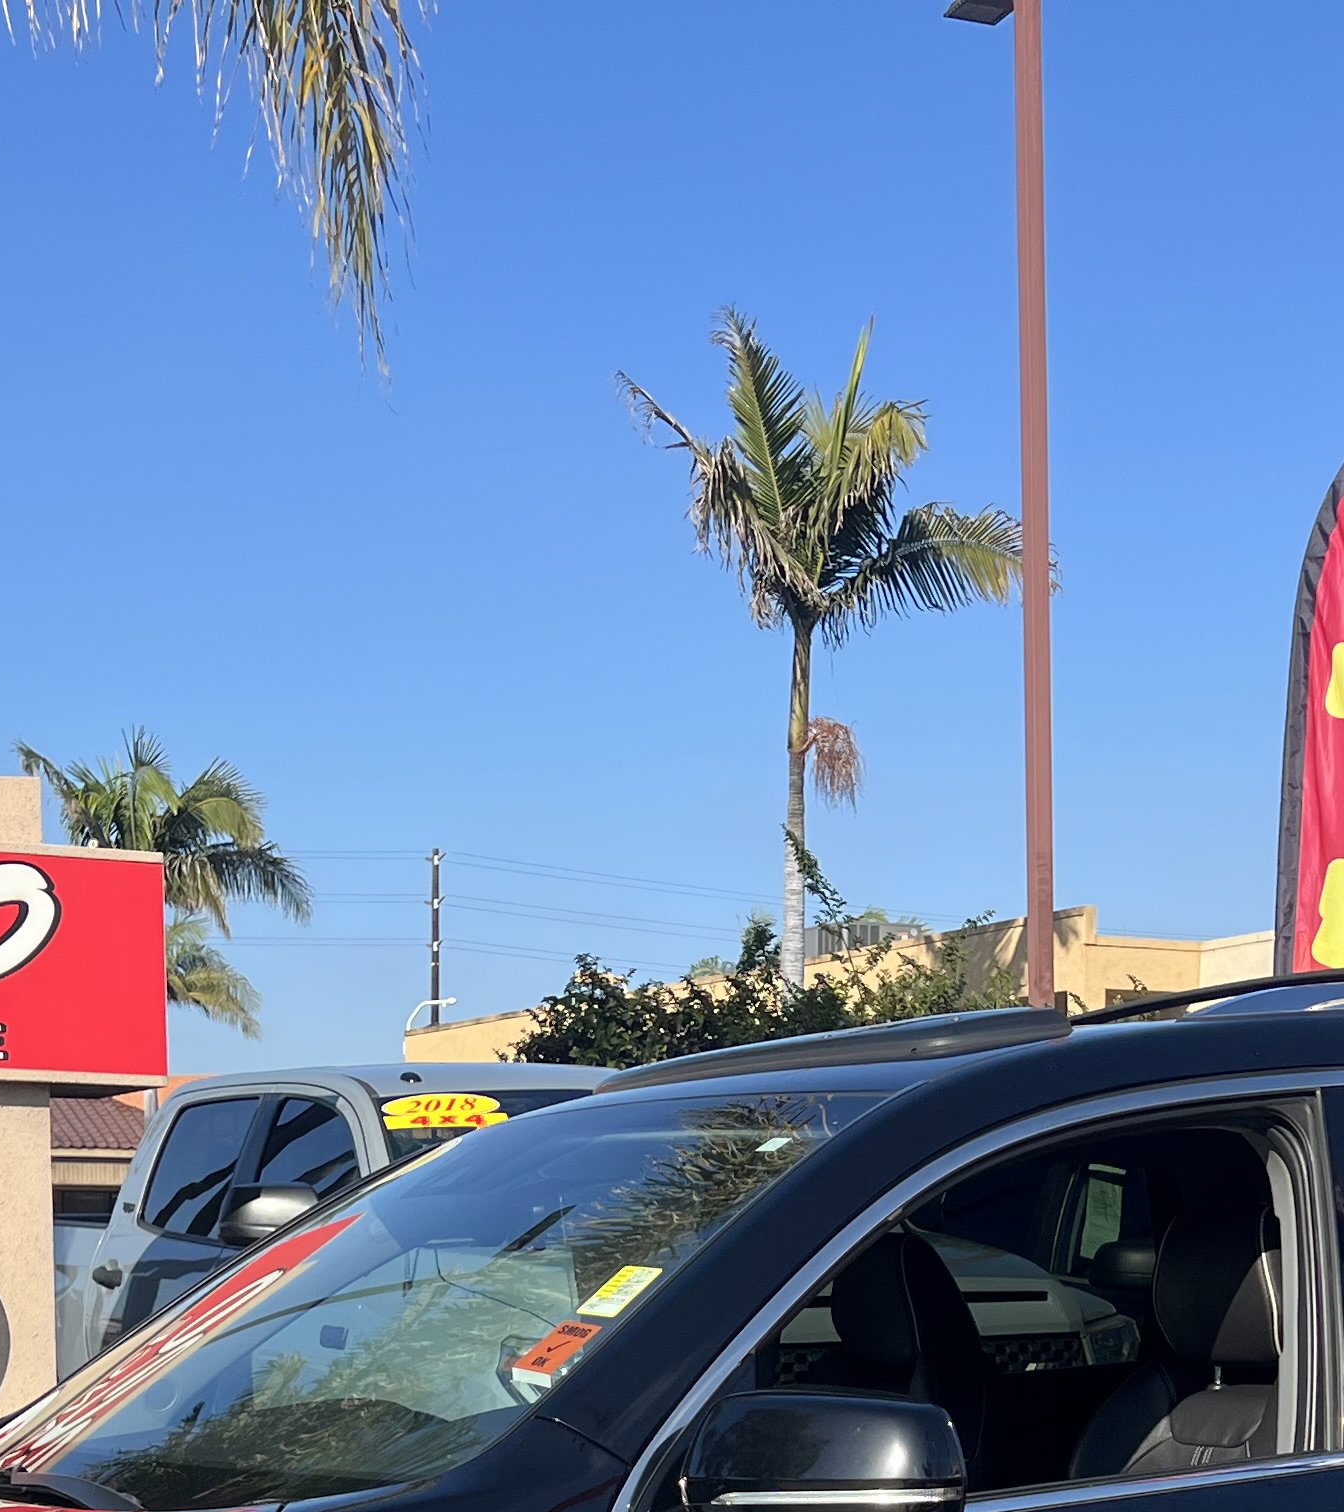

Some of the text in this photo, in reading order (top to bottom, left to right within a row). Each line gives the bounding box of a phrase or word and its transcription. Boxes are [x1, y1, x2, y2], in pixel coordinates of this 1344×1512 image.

[407, 1098, 477, 1114] 2018
[557, 1324, 593, 1339] SMOG
[530, 1356, 551, 1368] OK
